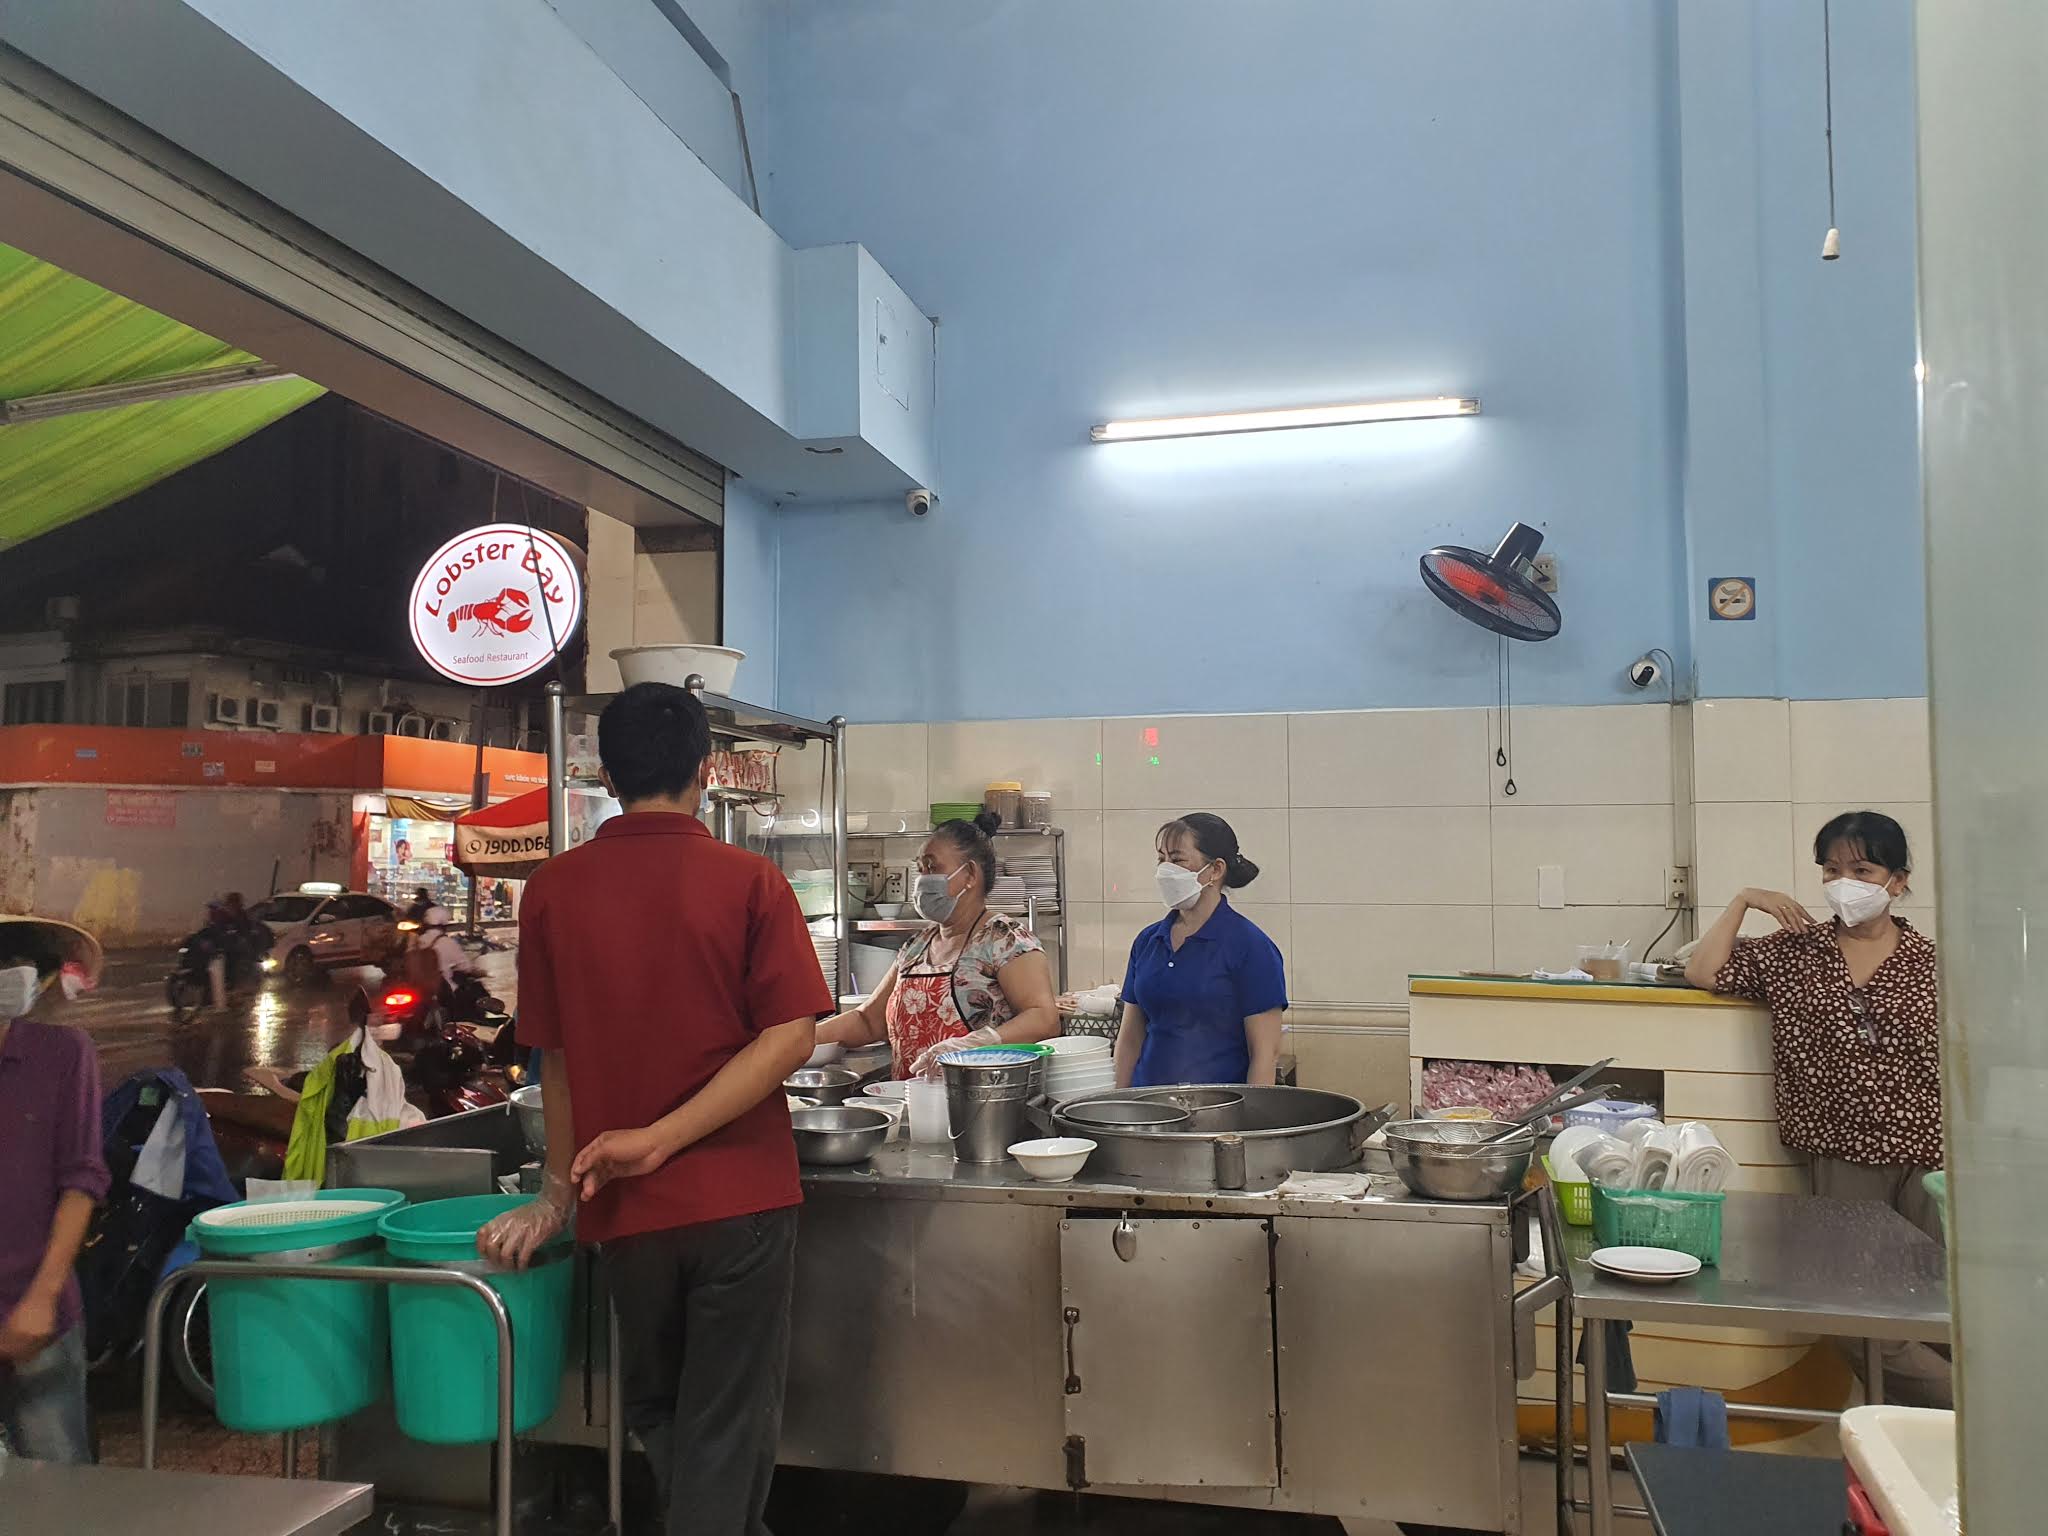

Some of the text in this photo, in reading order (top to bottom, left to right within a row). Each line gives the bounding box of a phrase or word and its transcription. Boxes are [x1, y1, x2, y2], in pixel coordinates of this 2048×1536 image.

[425, 542, 564, 617] Lobster Bay
[452, 651, 529, 665] Seafood Restaurant
